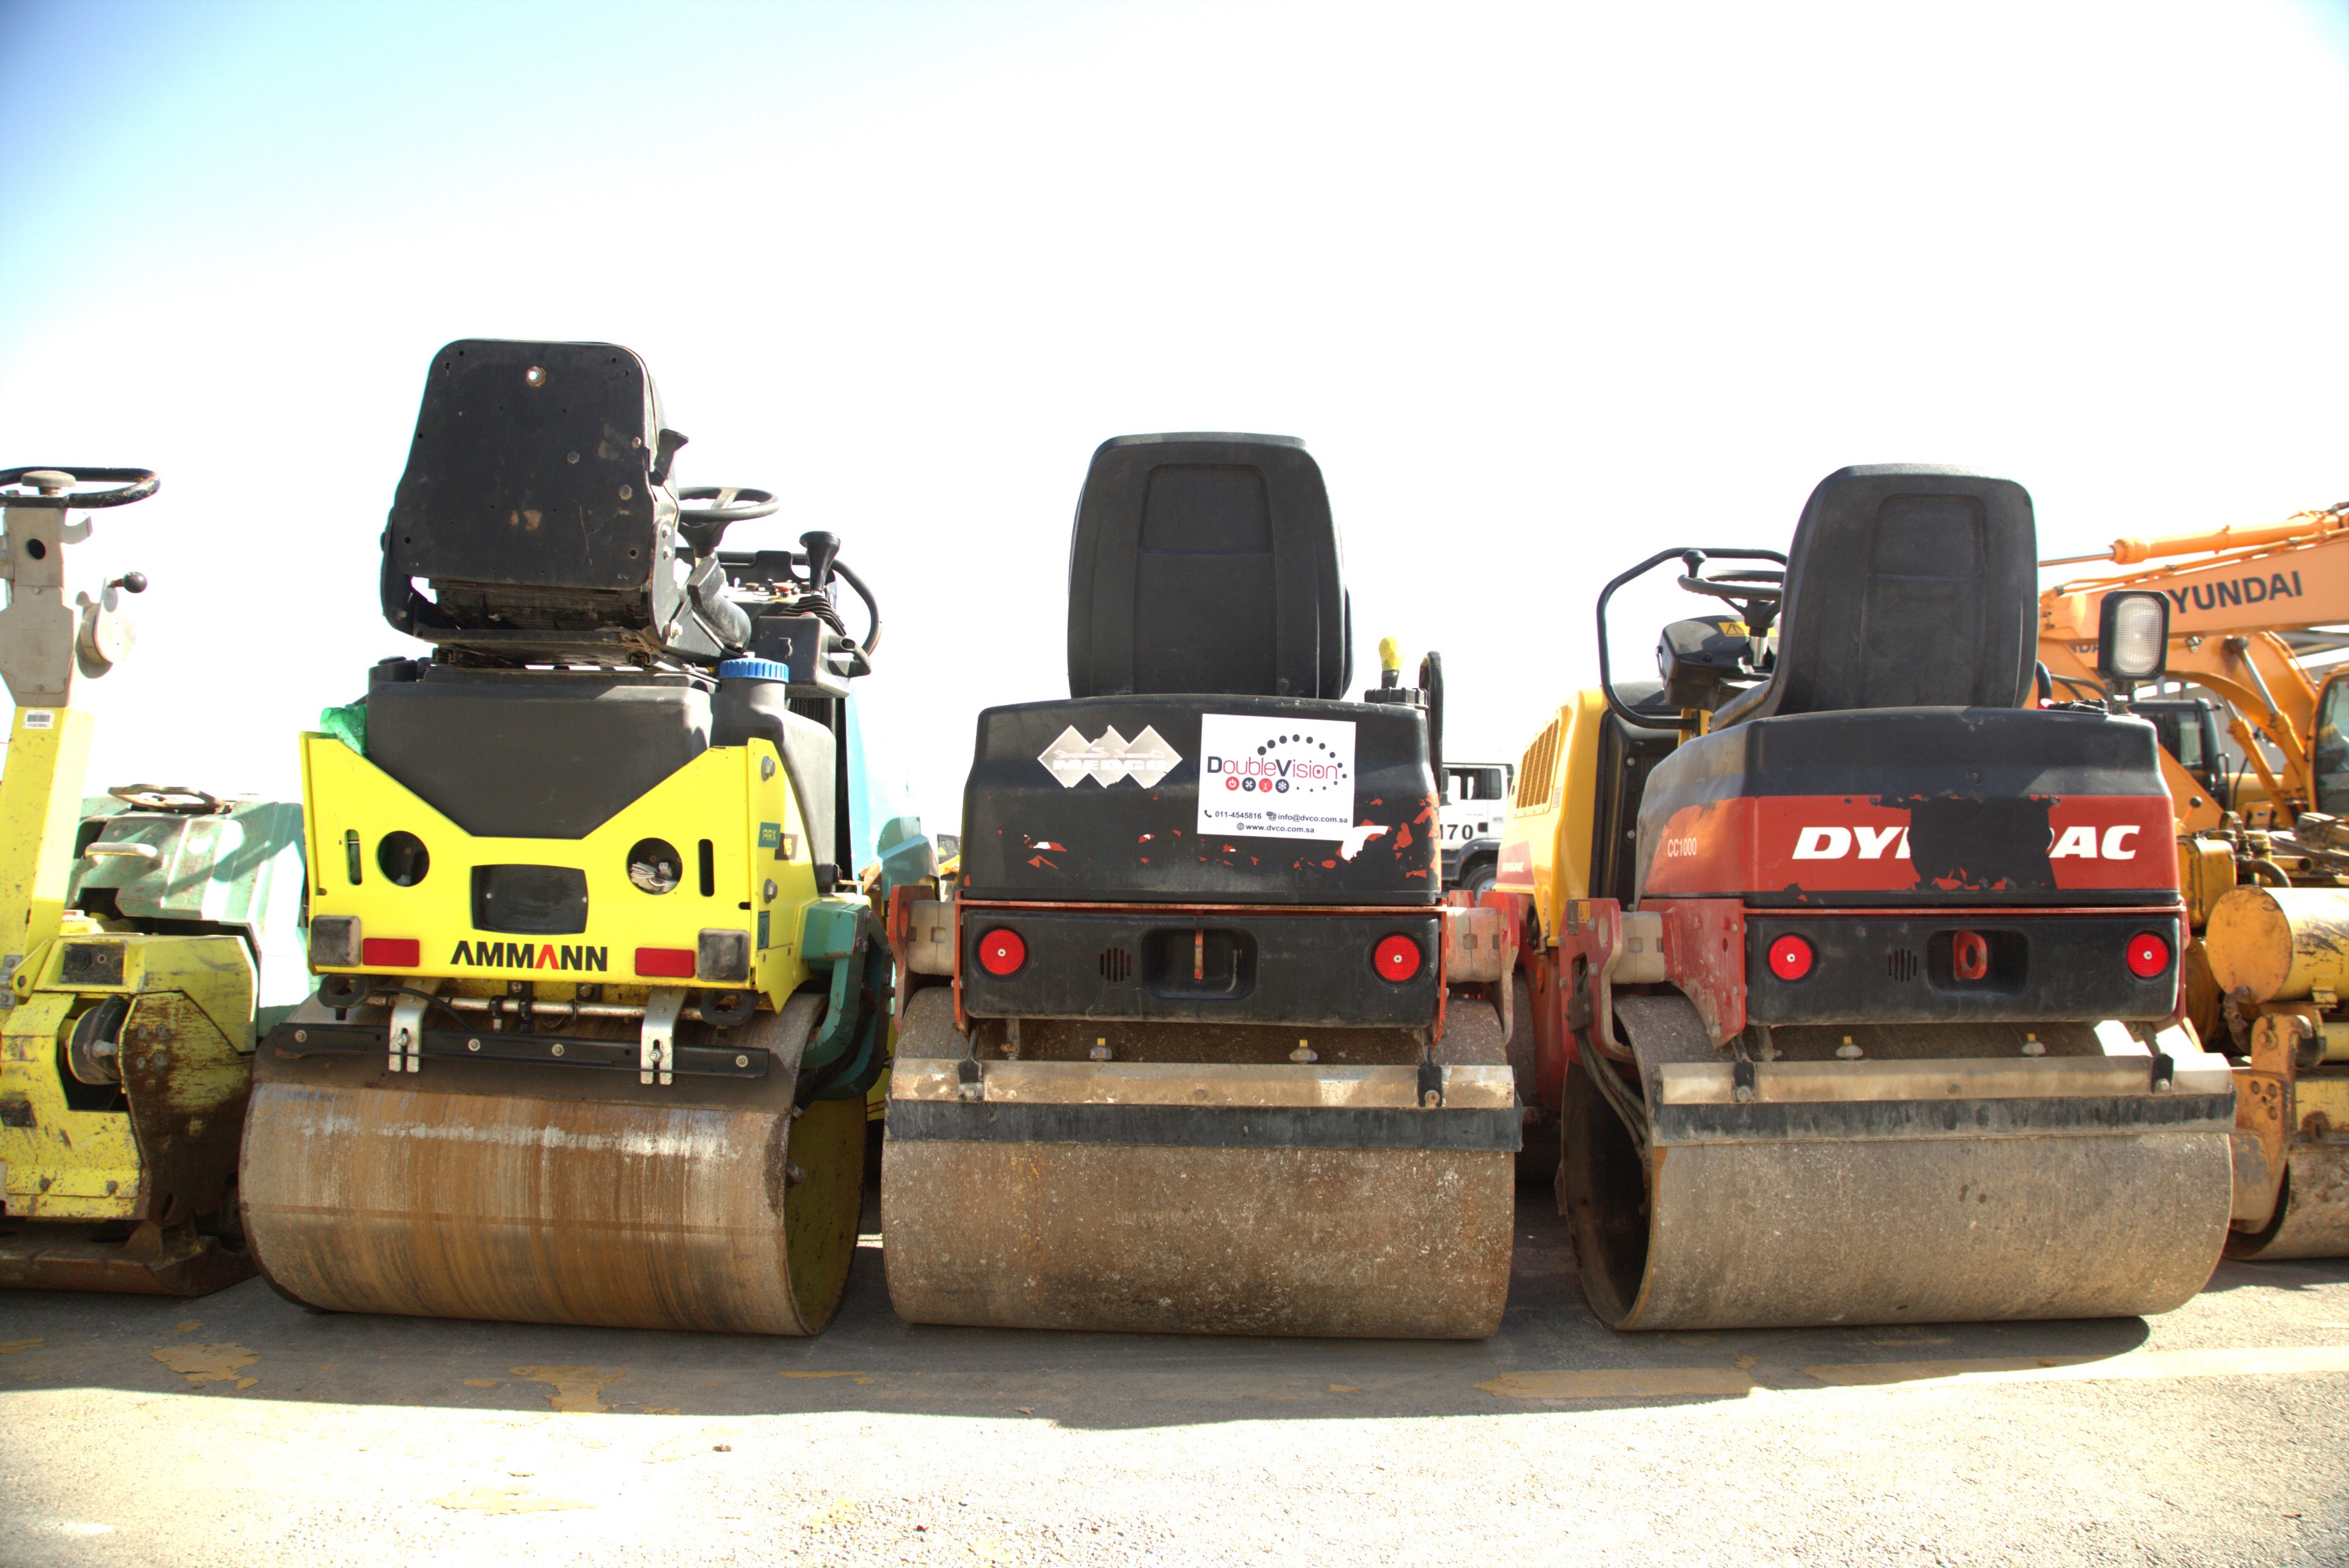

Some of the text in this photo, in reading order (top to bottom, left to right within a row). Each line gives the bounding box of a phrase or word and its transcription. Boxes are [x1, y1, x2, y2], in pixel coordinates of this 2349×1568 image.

[2167, 570, 2303, 614] YUNDAI
[1053, 760, 1167, 770] MEDCO
[1207, 756, 1338, 780] DoubleVision
[1215, 810, 1348, 824] 011-4545816 info@dvco.com.sa
[762, 828, 777, 842] ARX
[1246, 823, 1315, 834] www.dvco.com.sa
[1667, 837, 1697, 857] CC1000
[450, 940, 608, 972] AMMANN
